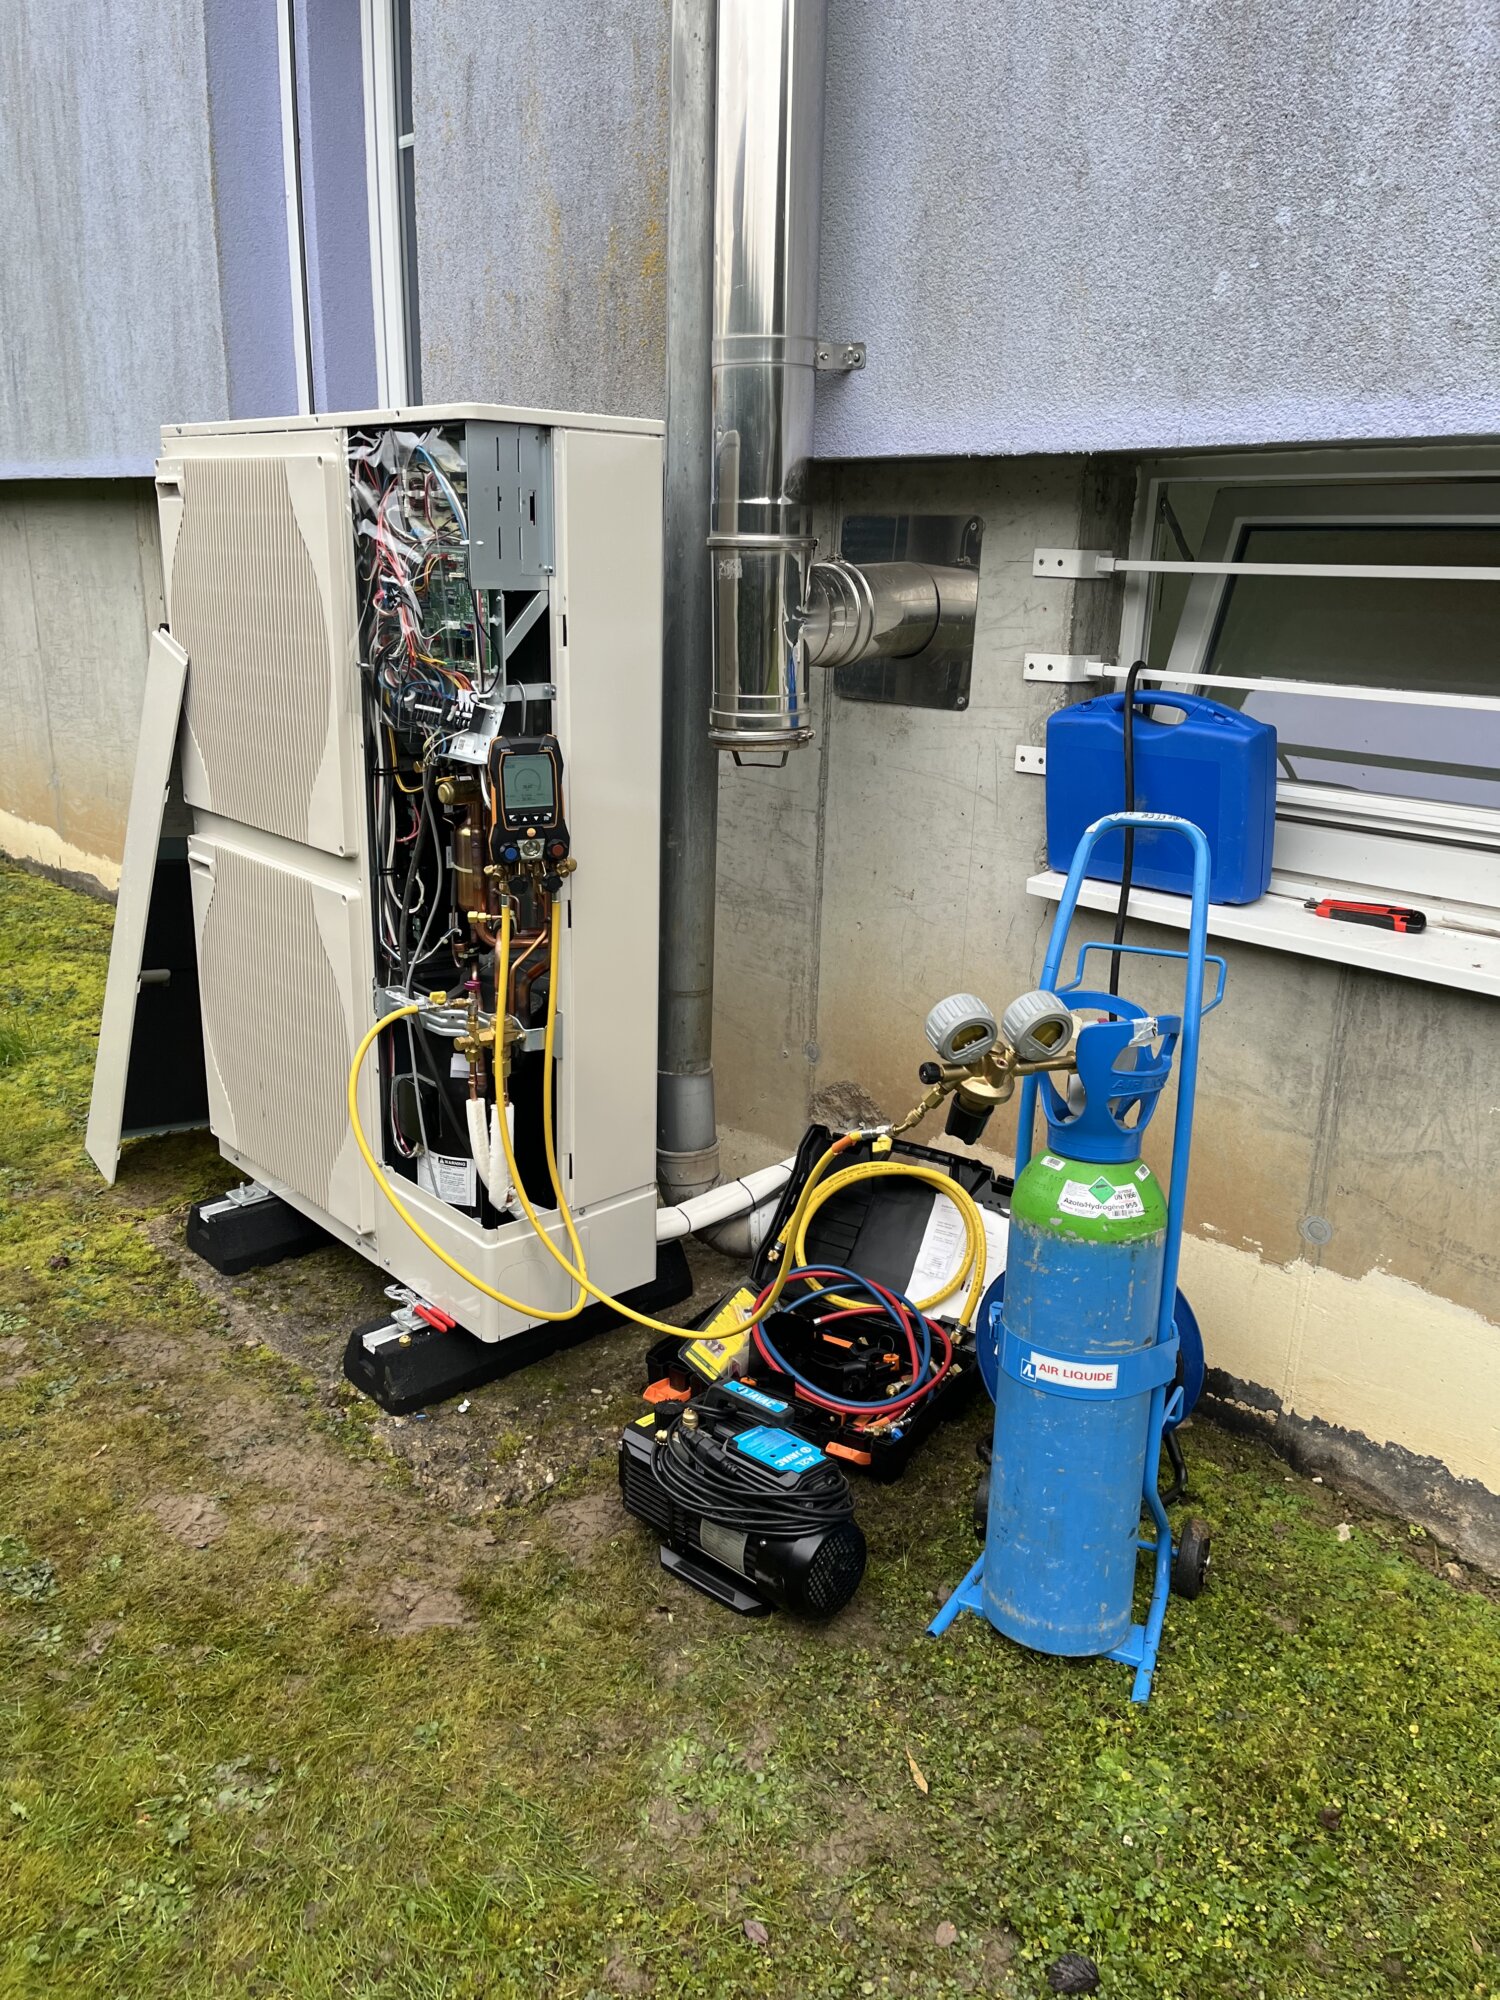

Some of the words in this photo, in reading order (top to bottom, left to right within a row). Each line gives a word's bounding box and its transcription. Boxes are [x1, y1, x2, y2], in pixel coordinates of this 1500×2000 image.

[1039, 1363, 1059, 1376] AIR
[1063, 1369, 1113, 1381] LIQUIDE
[747, 1391, 775, 1407] JAVAC
[774, 1451, 801, 1467] JAVAC
